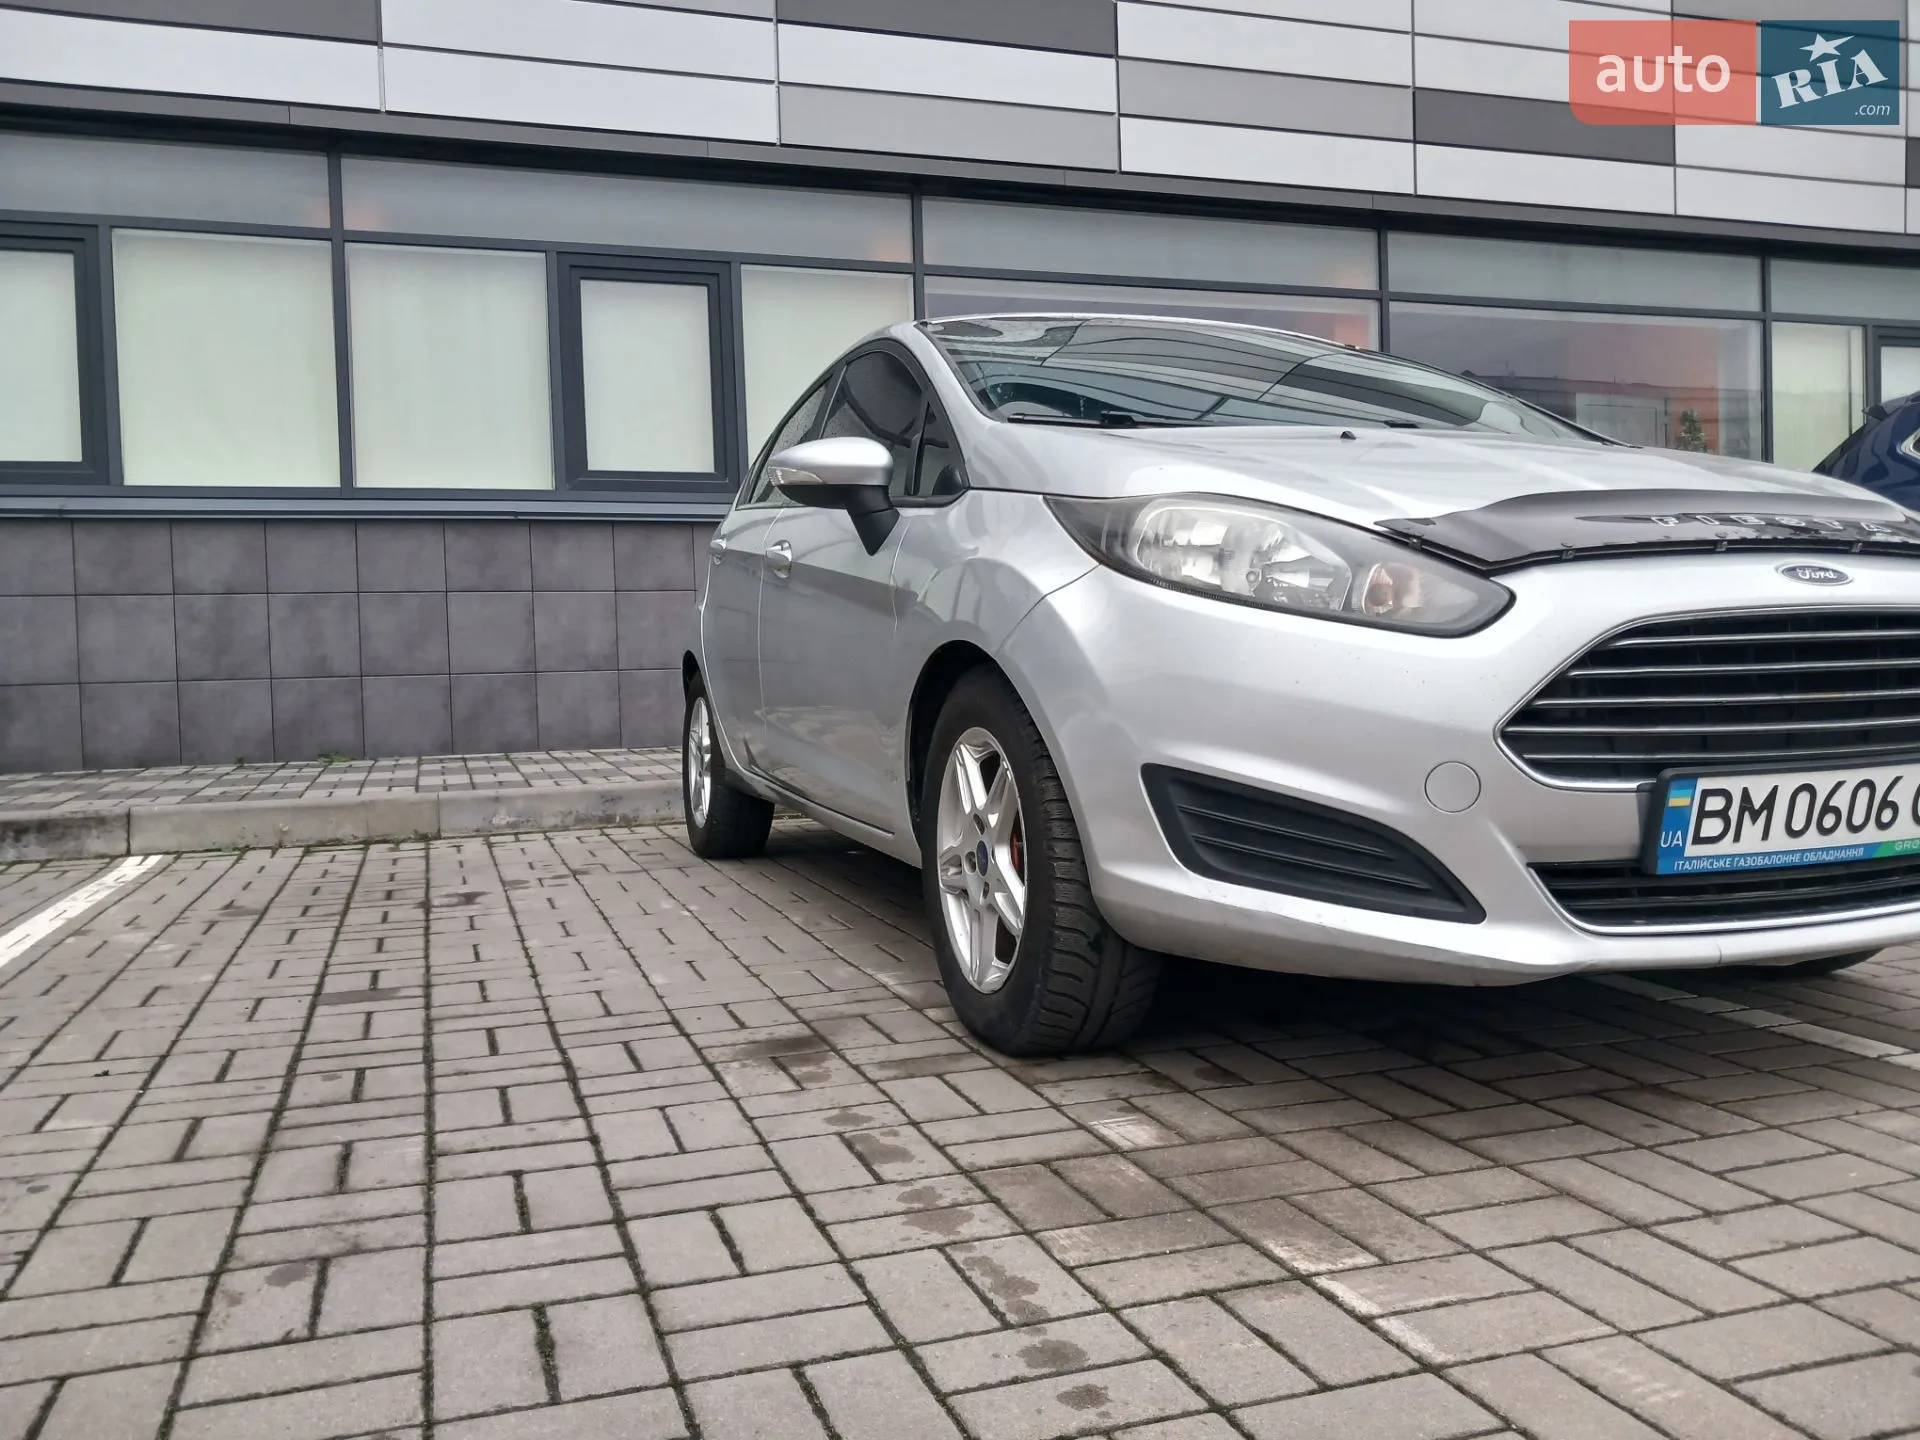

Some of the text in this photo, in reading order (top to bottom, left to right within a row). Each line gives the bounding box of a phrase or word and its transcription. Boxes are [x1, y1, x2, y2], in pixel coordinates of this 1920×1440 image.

[1650, 515, 1893, 533] FIESTA
[1795, 566, 1838, 580] Ford
[1784, 775, 1905, 839] 0606
[1660, 830, 1684, 849] UA
[1673, 846, 1865, 872] ІТАЛІЙСЬКЕ ГАЗОБАЛОННЕ ОБЛАДНАННЯ
